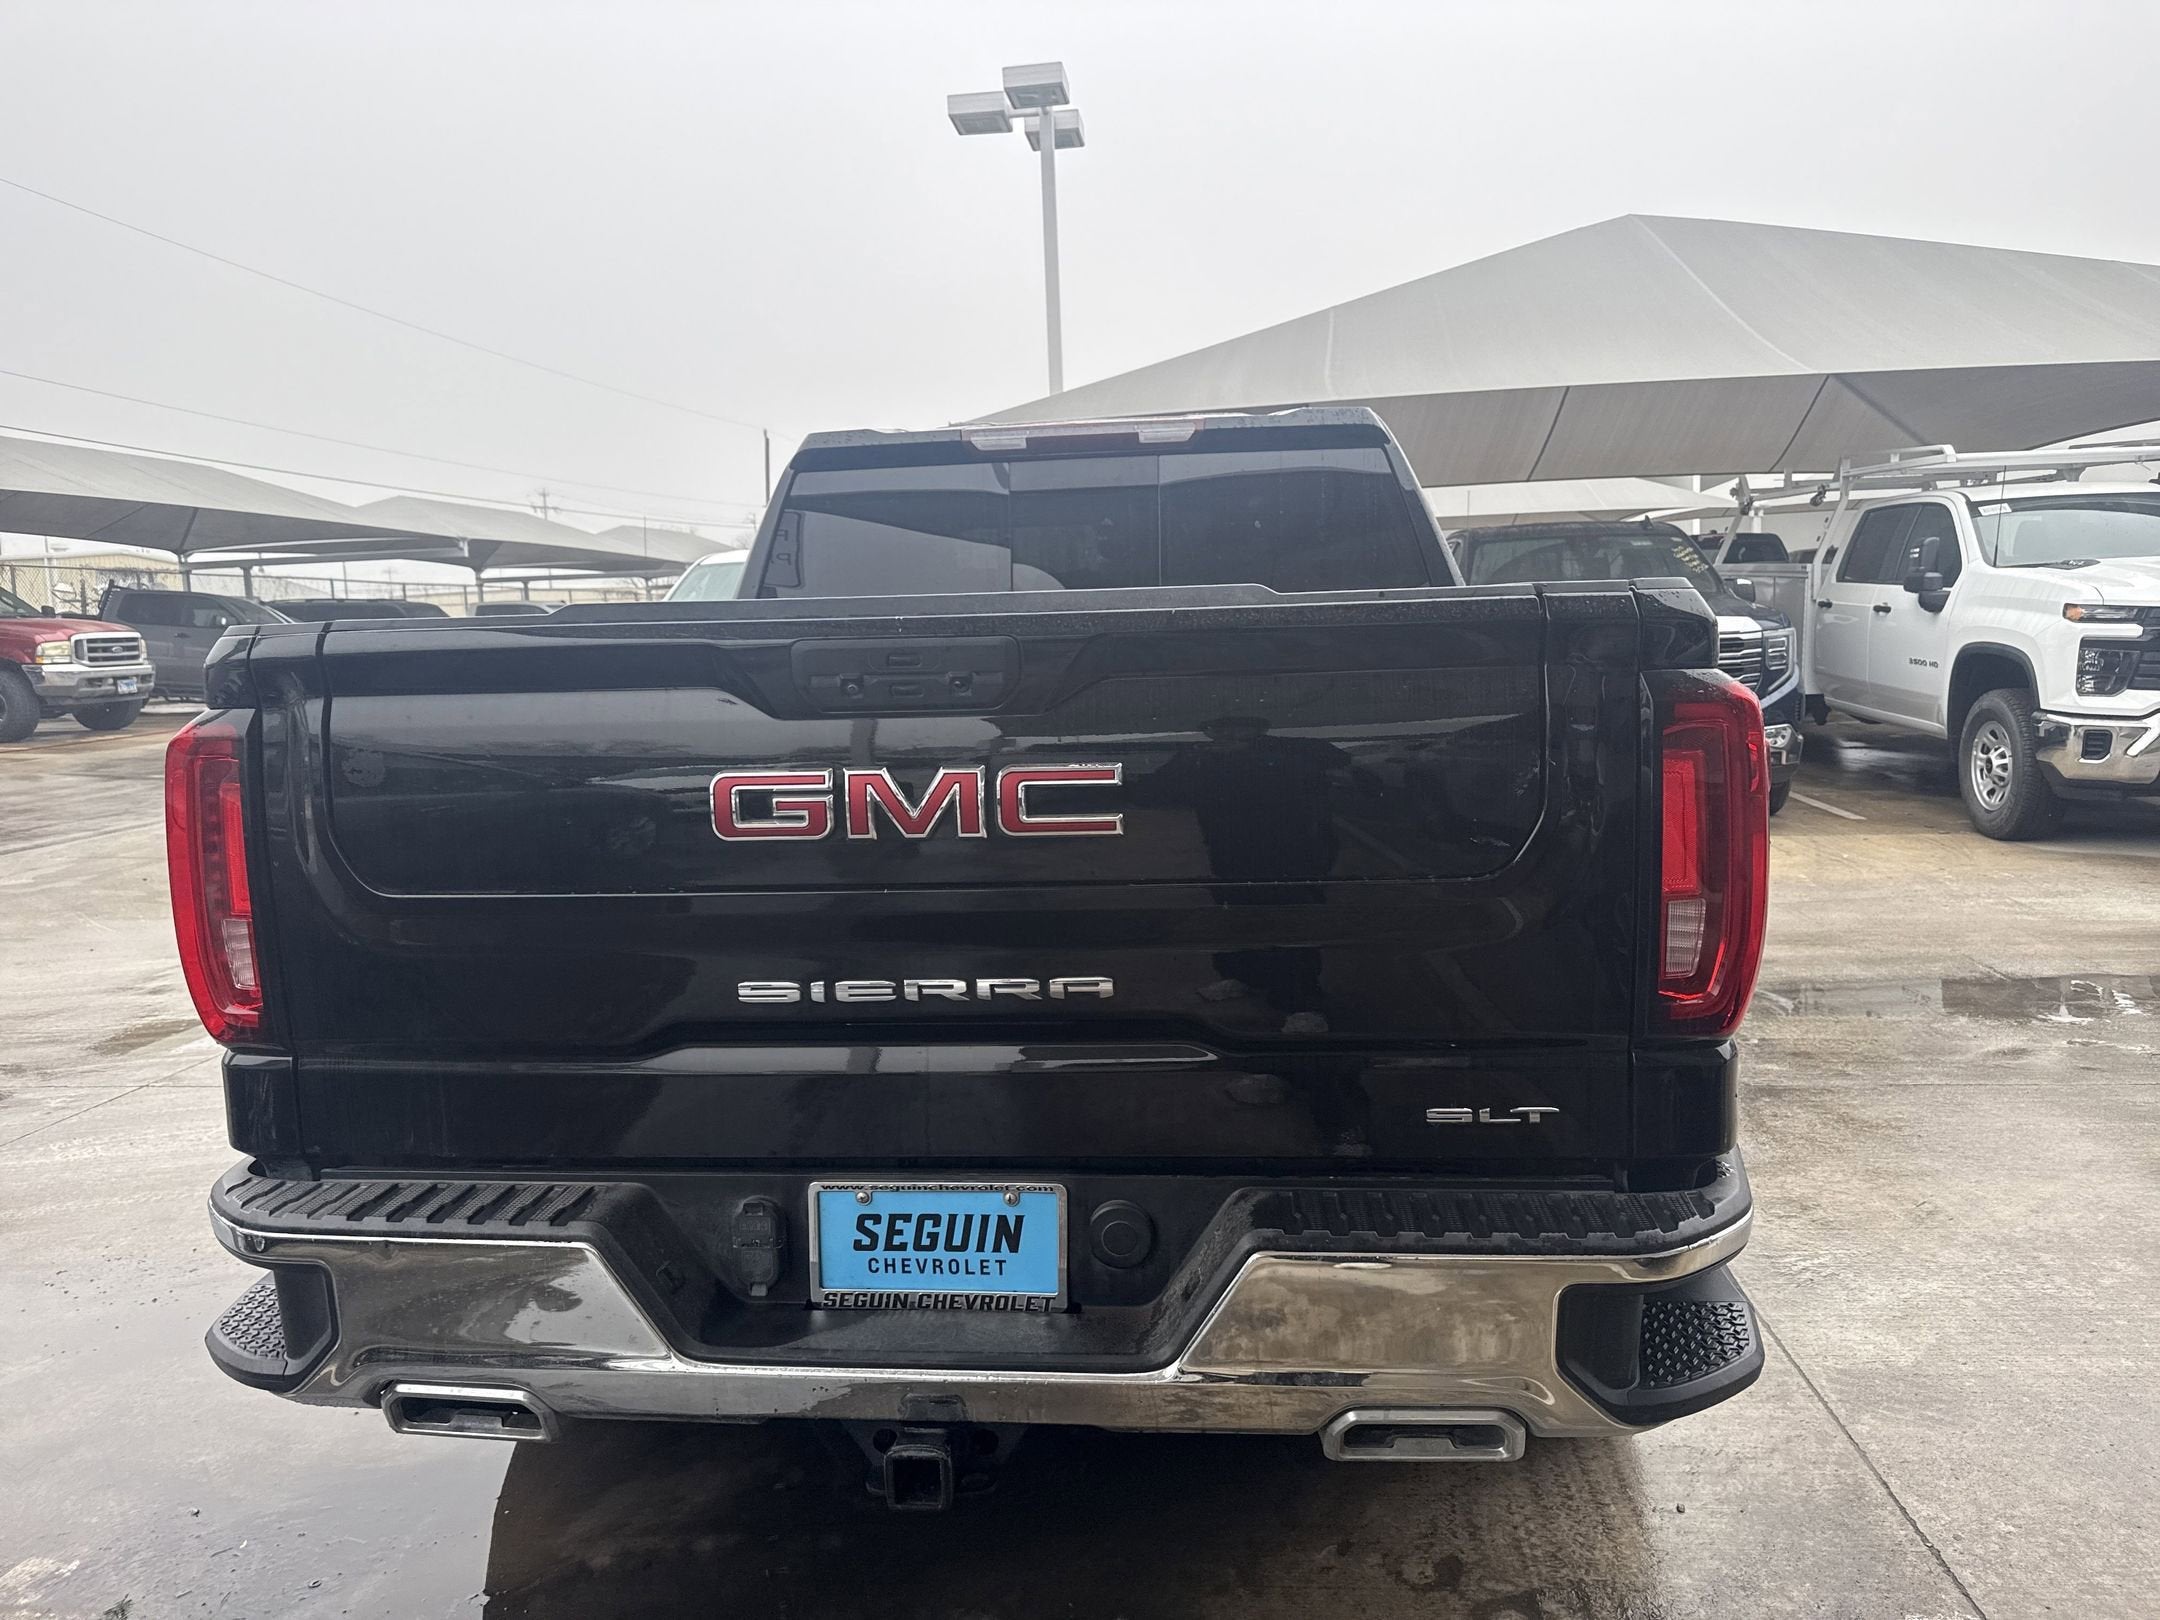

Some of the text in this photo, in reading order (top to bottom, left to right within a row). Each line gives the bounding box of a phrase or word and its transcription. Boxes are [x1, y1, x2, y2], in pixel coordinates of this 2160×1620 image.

[709, 763, 1124, 841] GMC
[737, 976, 1114, 1002] SIERRA
[1426, 1106, 1560, 1123] SLT
[852, 1213, 1025, 1253] SEGUIN
[868, 1257, 1007, 1275] CHEVROLET
[823, 1292, 1057, 1312] SEGUIN CHEVROLET
